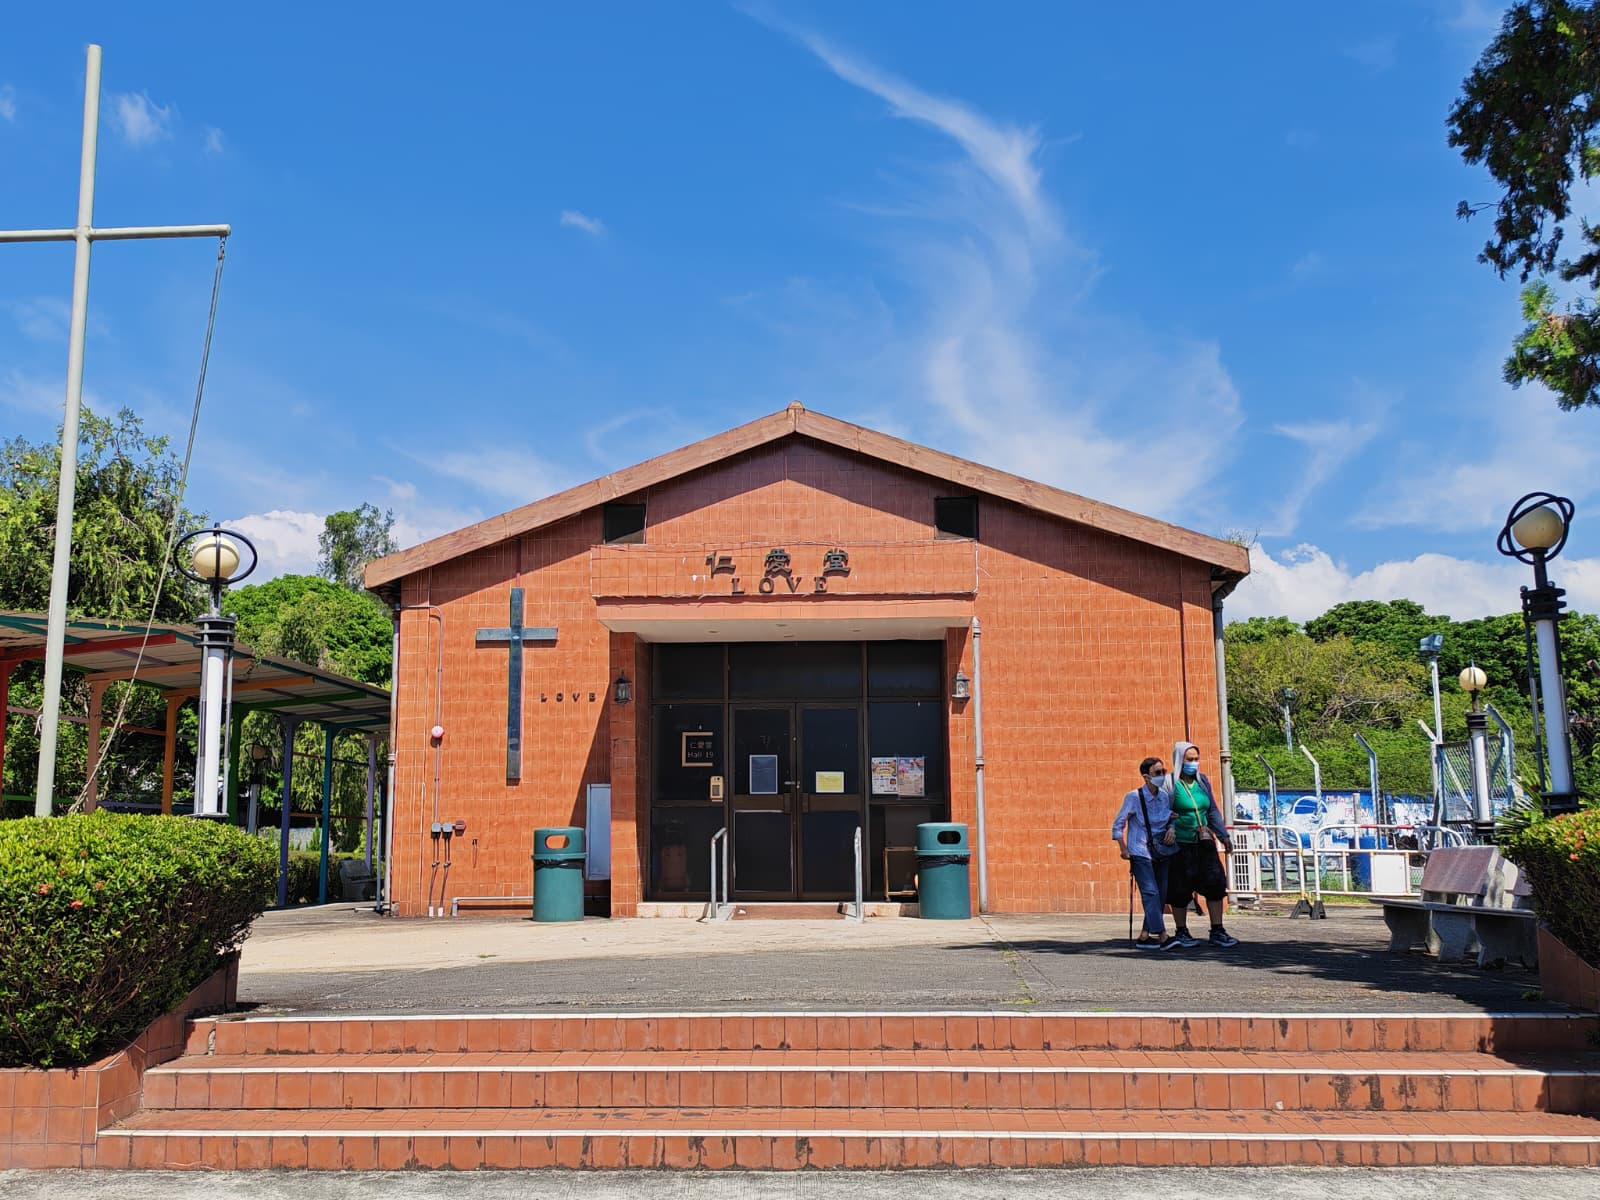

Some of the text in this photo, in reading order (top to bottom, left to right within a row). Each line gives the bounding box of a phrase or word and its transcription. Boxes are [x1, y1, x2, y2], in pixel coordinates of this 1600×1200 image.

[706, 548, 851, 579] 仁愛堂
[731, 576, 829, 594] LOVE
[540, 692, 596, 702] LOVE
